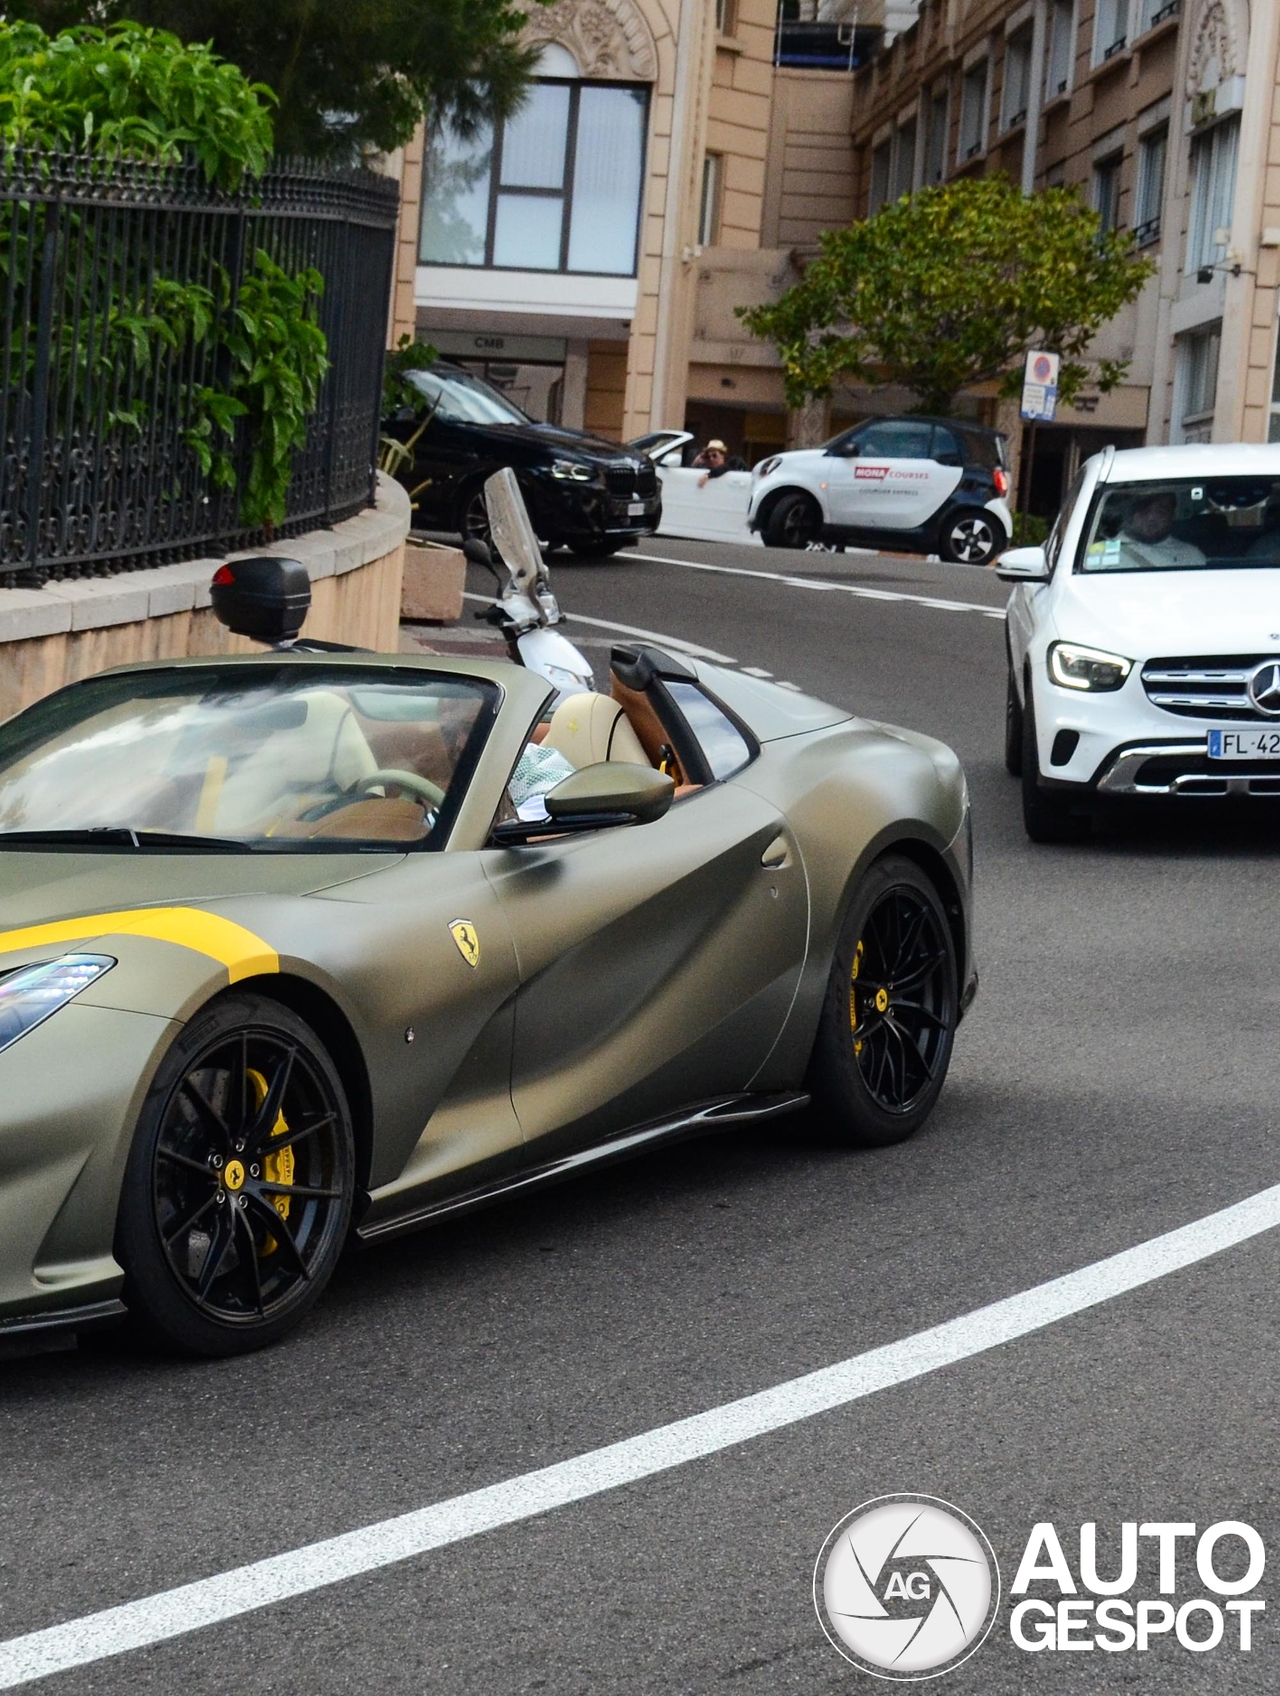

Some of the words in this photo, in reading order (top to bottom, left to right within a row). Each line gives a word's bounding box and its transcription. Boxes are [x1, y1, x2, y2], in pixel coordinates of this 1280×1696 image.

[474, 336, 504, 349] CMB
[856, 468, 885, 478] MONA
[889, 471, 929, 480] COURSES
